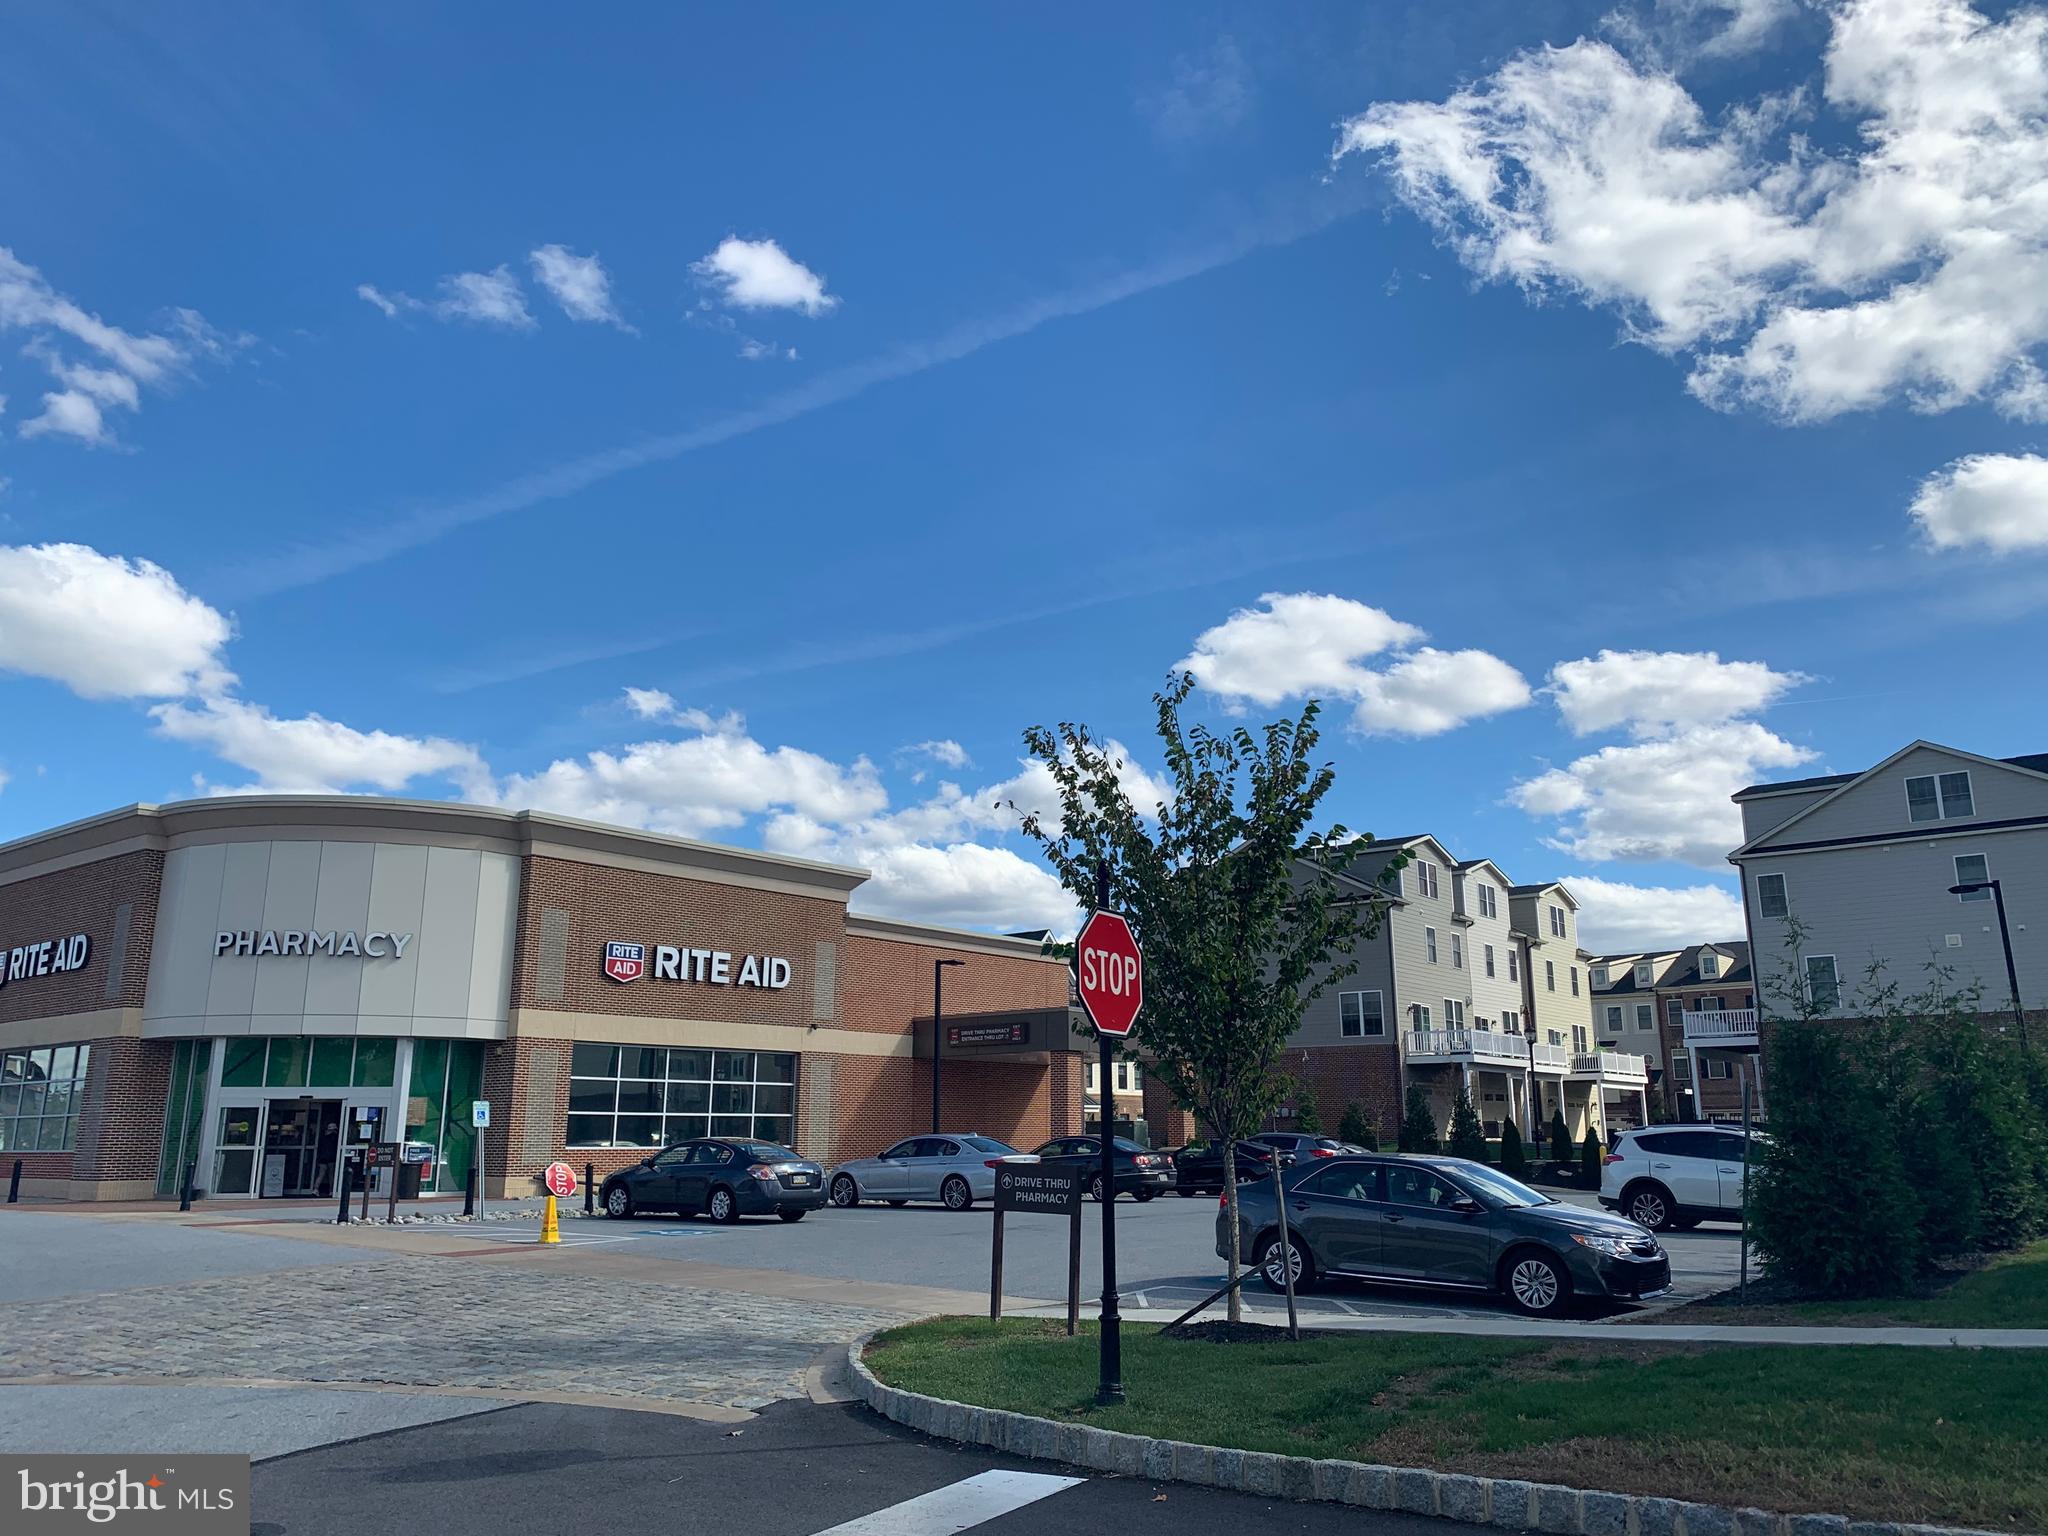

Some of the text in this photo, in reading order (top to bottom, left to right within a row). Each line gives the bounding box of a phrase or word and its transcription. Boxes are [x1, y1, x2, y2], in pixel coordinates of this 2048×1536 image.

[8, 934, 87, 980] RITE AID
[213, 930, 412, 958] PHARMACY
[612, 945, 639, 959] RITE
[613, 961, 636, 975] AID
[655, 945, 791, 988] RITE AID
[1084, 947, 1137, 997] STOP
[556, 1166, 568, 1194] STOP
[1014, 1176, 1071, 1189] DRIVE THRU
[1015, 1191, 1069, 1204] PHARMACY
